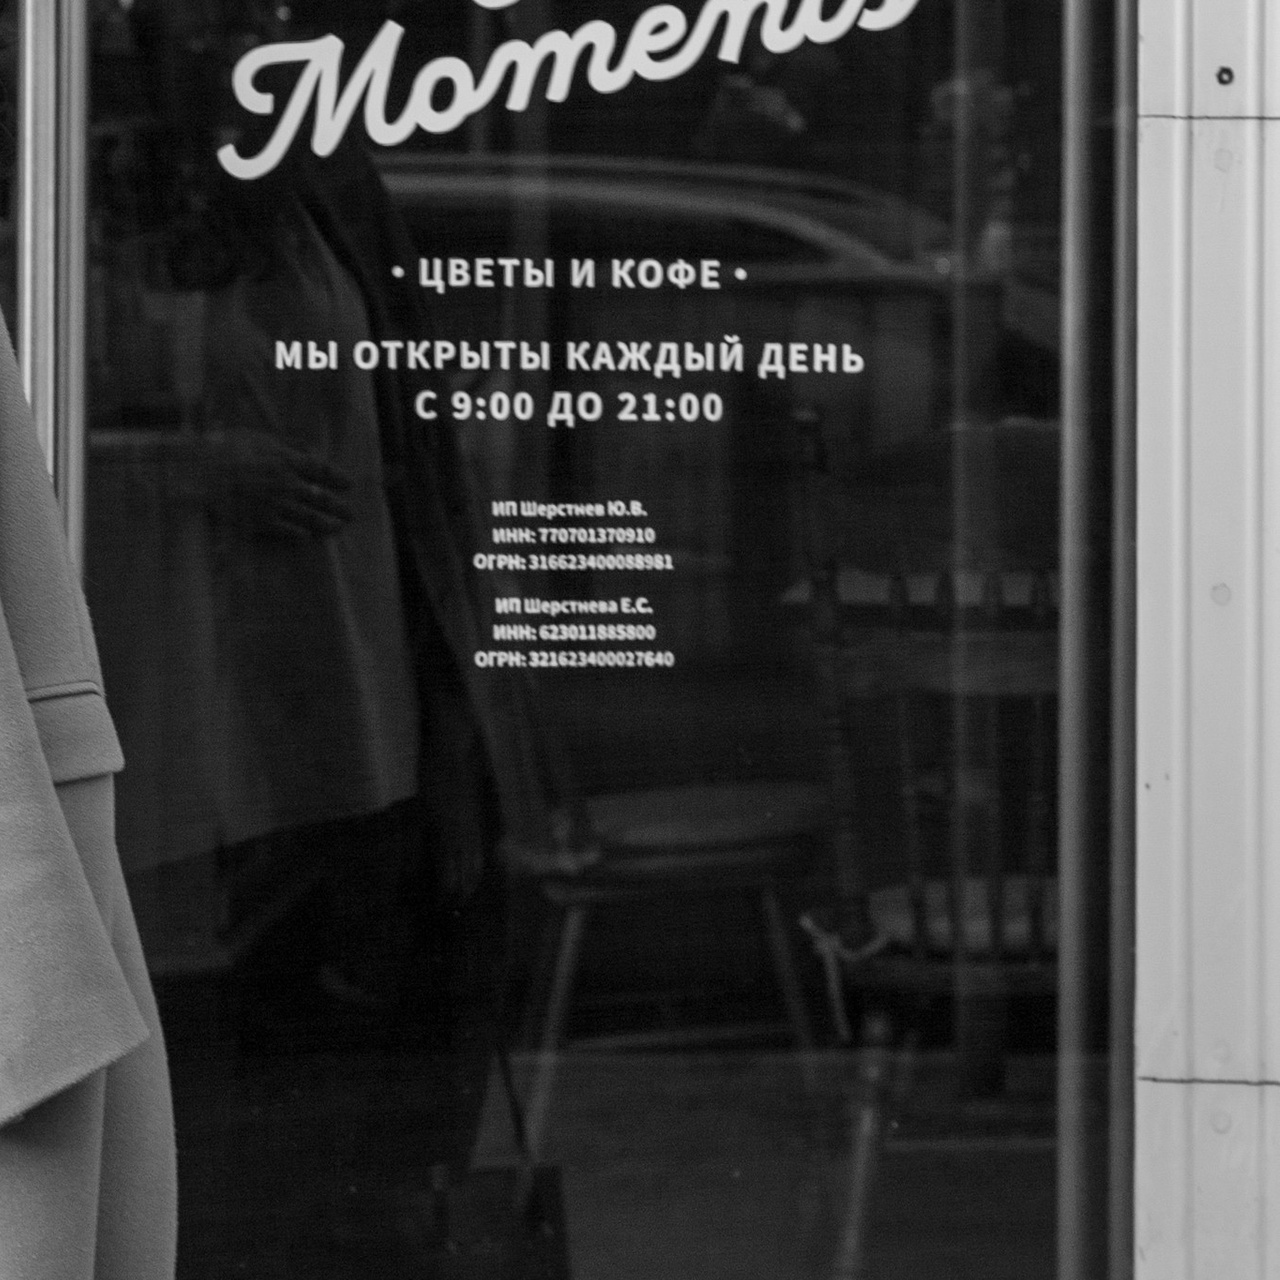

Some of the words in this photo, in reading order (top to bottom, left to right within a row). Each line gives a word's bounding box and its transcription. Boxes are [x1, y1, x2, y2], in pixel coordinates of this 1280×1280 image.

[419, 257, 554, 294] ЦВЕТЫ
[571, 258, 595, 288] И
[611, 258, 721, 290] КОФЕ
[275, 340, 338, 370] МЫ
[353, 340, 550, 371] ОТКРЫТЫ
[567, 334, 744, 379] КАЖДЫЙ
[757, 342, 865, 380] ДЕНЬ
[415, 390, 437, 420] С
[451, 390, 534, 421] 9:00
[547, 391, 603, 428] ДО
[617, 391, 723, 422] 21:00
[491, 500, 518, 517] ИП
[520, 500, 606, 520] Шерстнев
[492, 527, 537, 544] ИНН:
[538, 527, 656, 544] 770701370910
[473, 552, 527, 571] ОГРН:
[494, 597, 522, 614] ИП
[523, 598, 619, 617] Шерстнева
[620, 596, 654, 614] Е.С.
[492, 624, 538, 641] ИНН:
[474, 650, 527, 668] ОГРН:
[528, 650, 675, 668] 321623400027640
